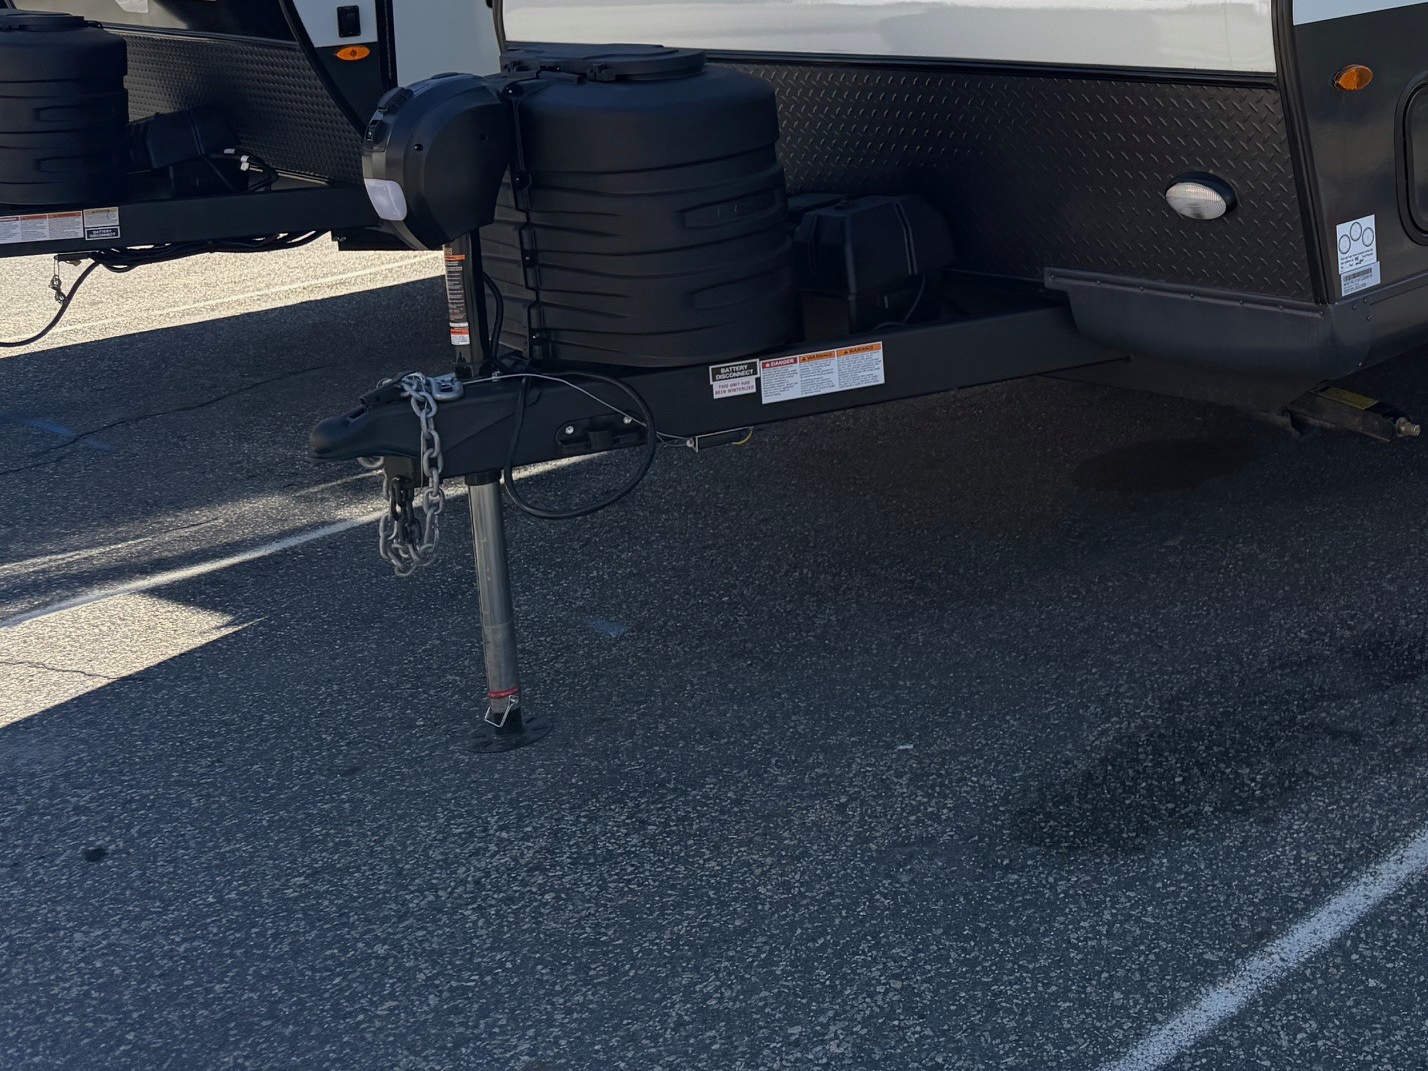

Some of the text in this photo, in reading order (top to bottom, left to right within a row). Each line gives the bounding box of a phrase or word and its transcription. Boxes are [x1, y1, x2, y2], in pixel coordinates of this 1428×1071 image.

[771, 358, 794, 367] DANGER
[720, 364, 748, 374] BATTERY
[715, 369, 754, 380] DISCONNECT
